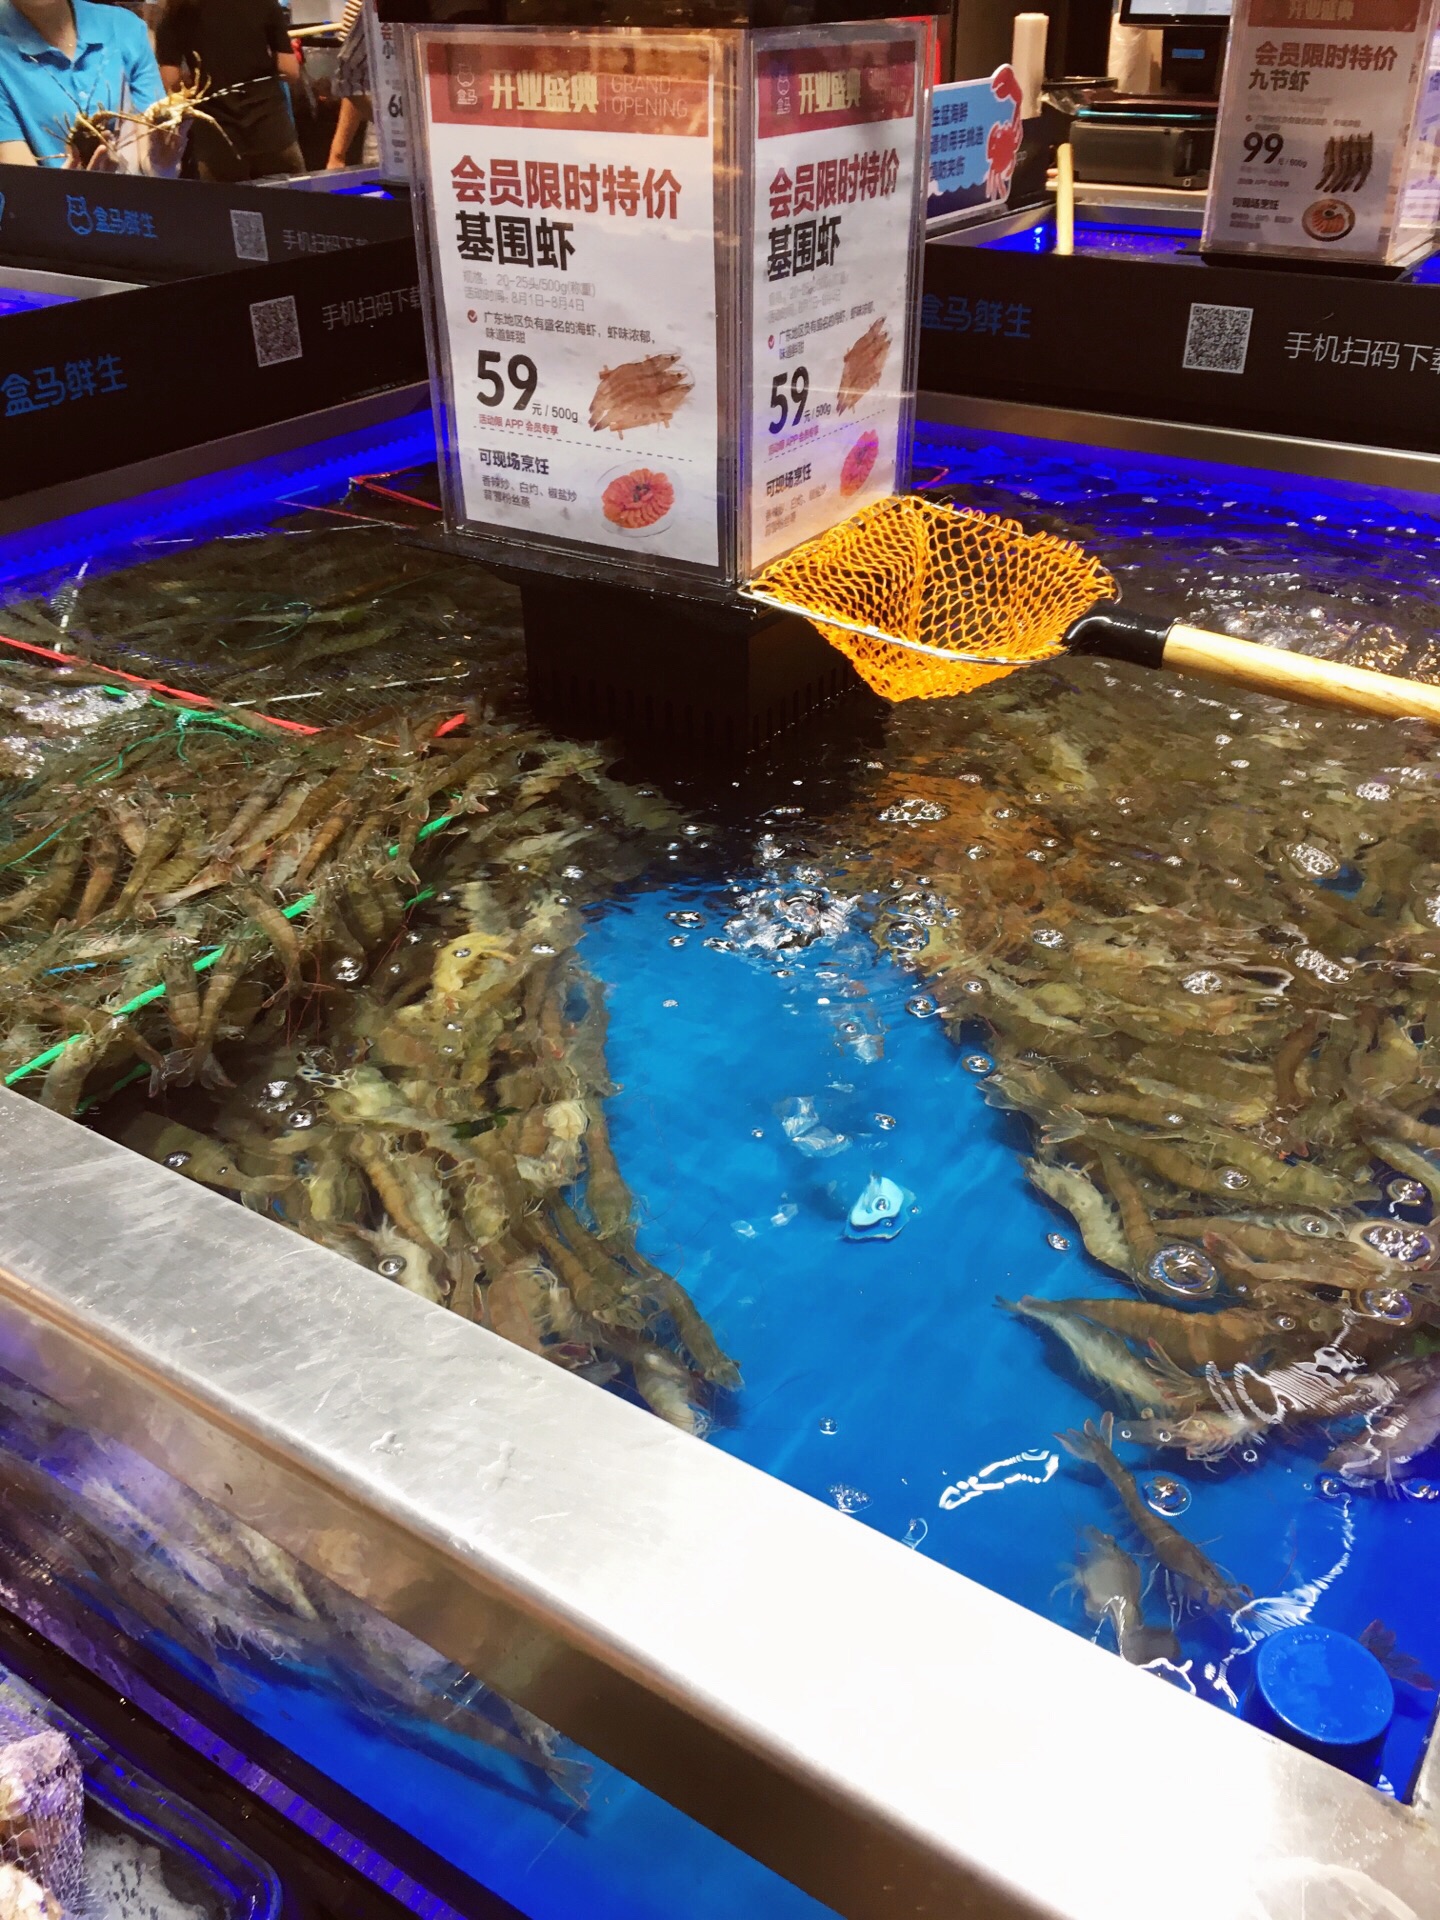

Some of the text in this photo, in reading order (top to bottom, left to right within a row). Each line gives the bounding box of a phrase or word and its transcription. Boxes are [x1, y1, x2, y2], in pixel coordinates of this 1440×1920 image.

[1255, 41, 1398, 71] 会员限时特价
[490, 70, 599, 113] 开业盛典
[610, 76, 671, 95] GRAND
[1248, 69, 1311, 92] 九节虾
[610, 97, 688, 118] OPENING
[1243, 132, 1284, 164] 99
[451, 155, 682, 219] 会员限时特价
[769, 148, 899, 220] 会员限时特价
[92, 207, 157, 239] 盒马鲜生
[455, 209, 576, 271] 基围虾
[768, 215, 842, 282] 基围虾
[1, 353, 128, 417] 盒马鲜生
[477, 350, 538, 411] 59
[768, 366, 810, 434] 59
[478, 447, 550, 475] 可现场烹饪
